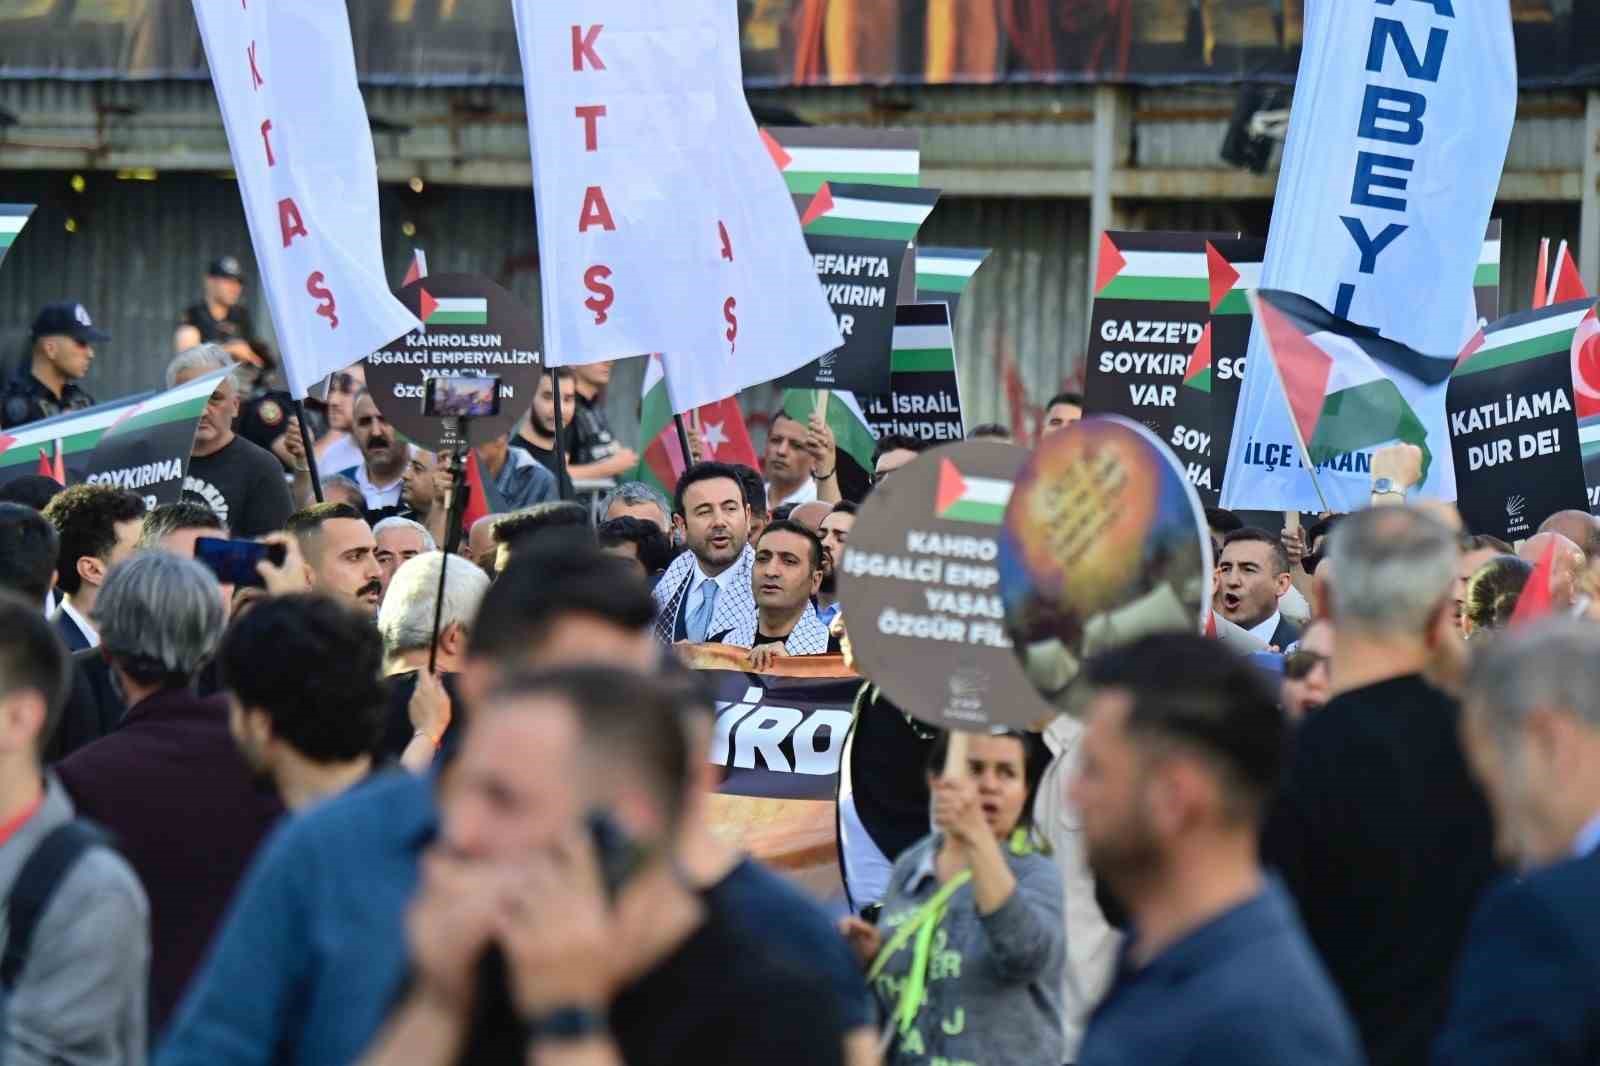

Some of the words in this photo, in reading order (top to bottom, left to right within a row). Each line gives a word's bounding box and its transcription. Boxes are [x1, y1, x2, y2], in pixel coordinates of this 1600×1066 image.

[814, 254, 889, 277] EFAH'TA
[823, 284, 885, 307] YKIRIM
[406, 334, 501, 347] KAHROLSUN
[1100, 319, 1203, 344] GAZZE'D
[432, 350, 540, 364] EMPERYALİZM
[1098, 351, 1192, 375] SOYKIR
[393, 382, 426, 398] ÖZG
[1129, 384, 1177, 406] VAR
[892, 391, 959, 414] İSRAİL
[1451, 388, 1571, 436] KATLİAMA
[872, 419, 963, 440] STİN'DEN
[1244, 437, 1293, 472] İLÇE
[1468, 437, 1513, 471] DUR
[1518, 428, 1561, 460] DE!
[86, 458, 182, 489] SOYKIRIMA
[906, 529, 999, 560] KAHRO
[925, 588, 1005, 619] YAŞAS
[877, 608, 965, 643] ÖZGÜR
[708, 686, 854, 776] İRO
